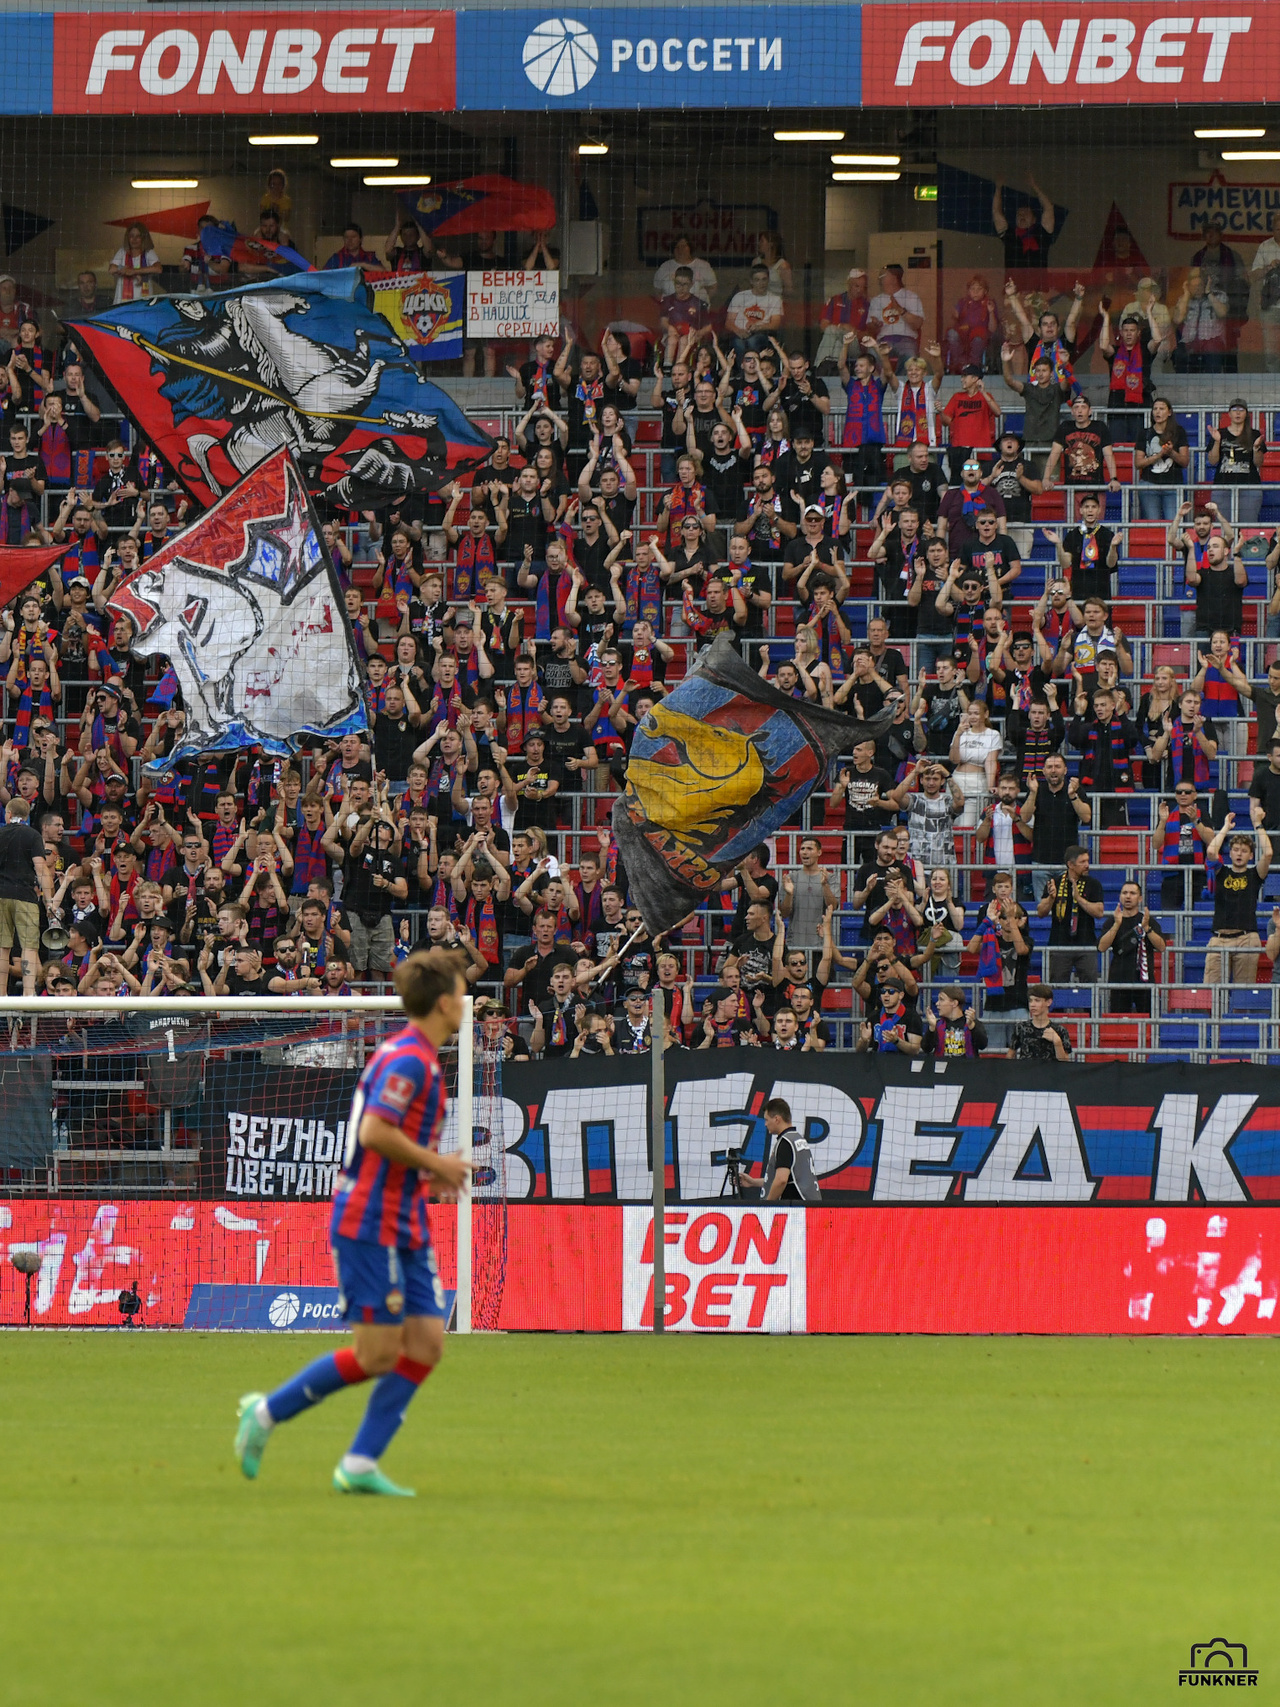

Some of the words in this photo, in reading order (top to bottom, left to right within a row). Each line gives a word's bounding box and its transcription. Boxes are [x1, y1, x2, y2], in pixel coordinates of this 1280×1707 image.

[85, 27, 435, 95] FONBET
[612, 37, 782, 73] РОССЕТИ
[894, 16, 1252, 87] FONBET
[469, 292, 493, 305] ТЫ
[482, 271, 544, 287] ВЕНЯ-1
[402, 293, 449, 315] ЦСКА
[470, 306, 480, 321] В
[483, 304, 531, 321] НАШИХ
[164, 1029, 179, 1063] 1
[226, 1111, 351, 1162] ВЕРНЫ
[1154, 1094, 1259, 1200] К
[640, 1212, 788, 1265] FON
[639, 1273, 788, 1328] BET
